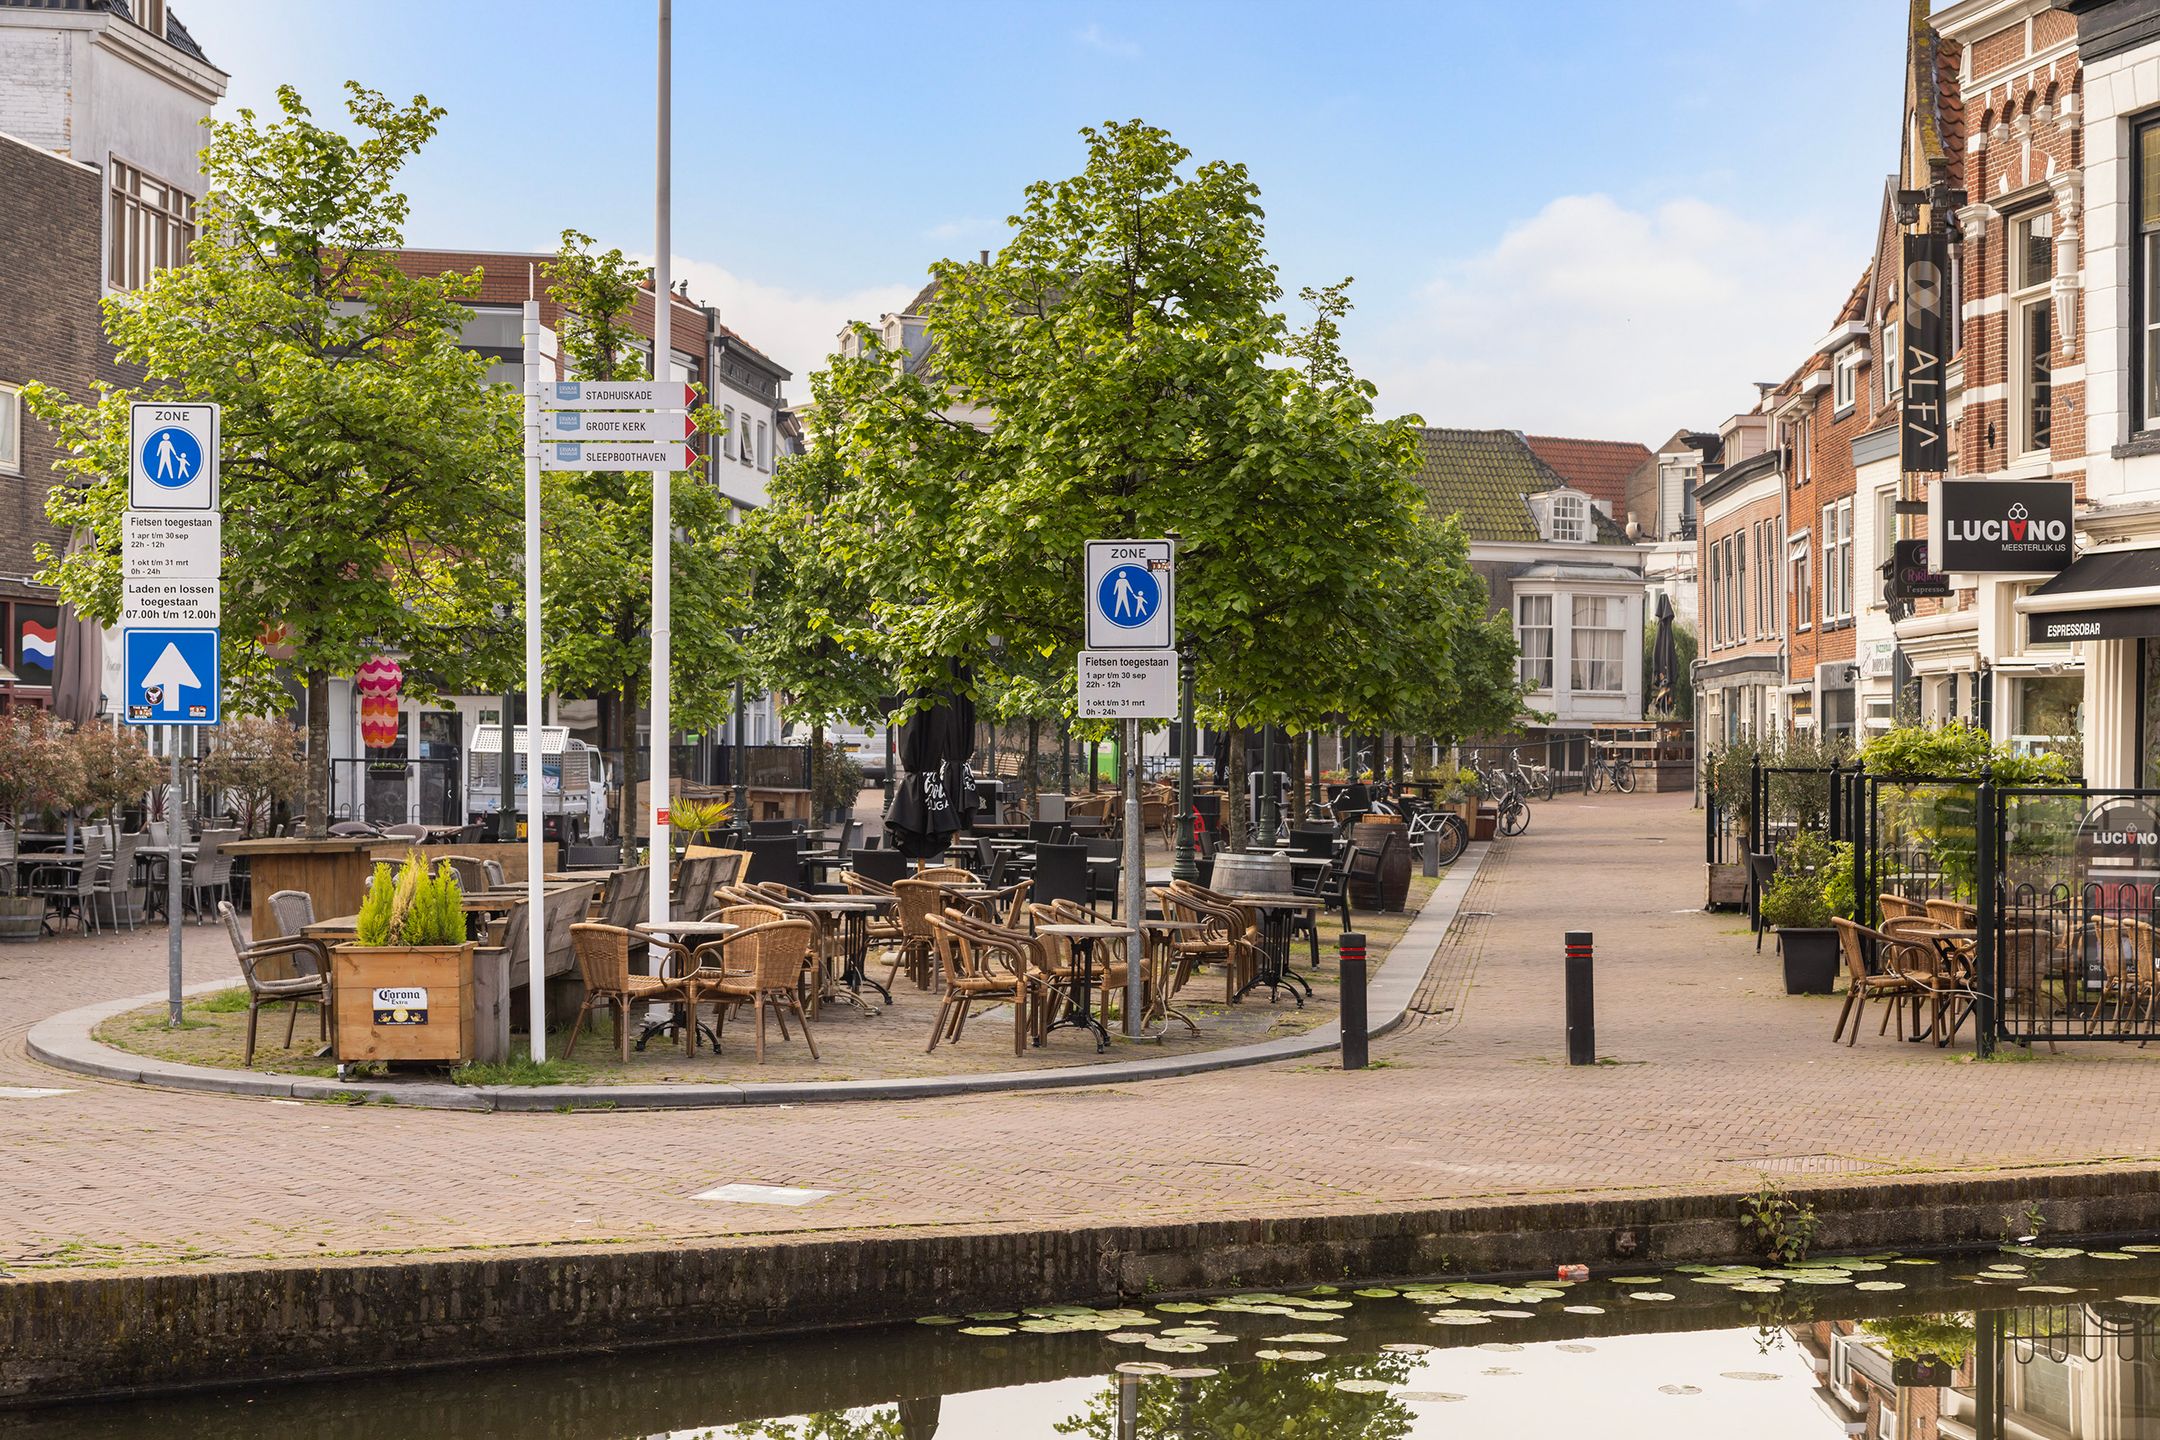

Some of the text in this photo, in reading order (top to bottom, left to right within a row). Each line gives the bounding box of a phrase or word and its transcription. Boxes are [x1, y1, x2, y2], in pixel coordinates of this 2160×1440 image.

[586, 391, 652, 400] STADHUISKADE
[155, 411, 190, 421] ZONE
[586, 422, 646, 431] GROOTE KERK
[586, 453, 666, 462] SLEEPBOOTHAVEN
[130, 517, 212, 528] Fietsen toegestaan
[1947, 519, 2066, 542] LUCIANO
[1111, 549, 1146, 558] ZONE
[128, 585, 160, 594] Laden
[180, 585, 214, 594] lossen
[141, 598, 198, 608] toegestaan
[126, 610, 216, 619] 07.00h t/m 12.00h
[2047, 623, 2100, 637] ESPRESSOBAR
[1085, 657, 1169, 668] Fietsen toegestaan
[2093, 832, 2158, 845] LUCIANO
[379, 990, 420, 1002] Corona
